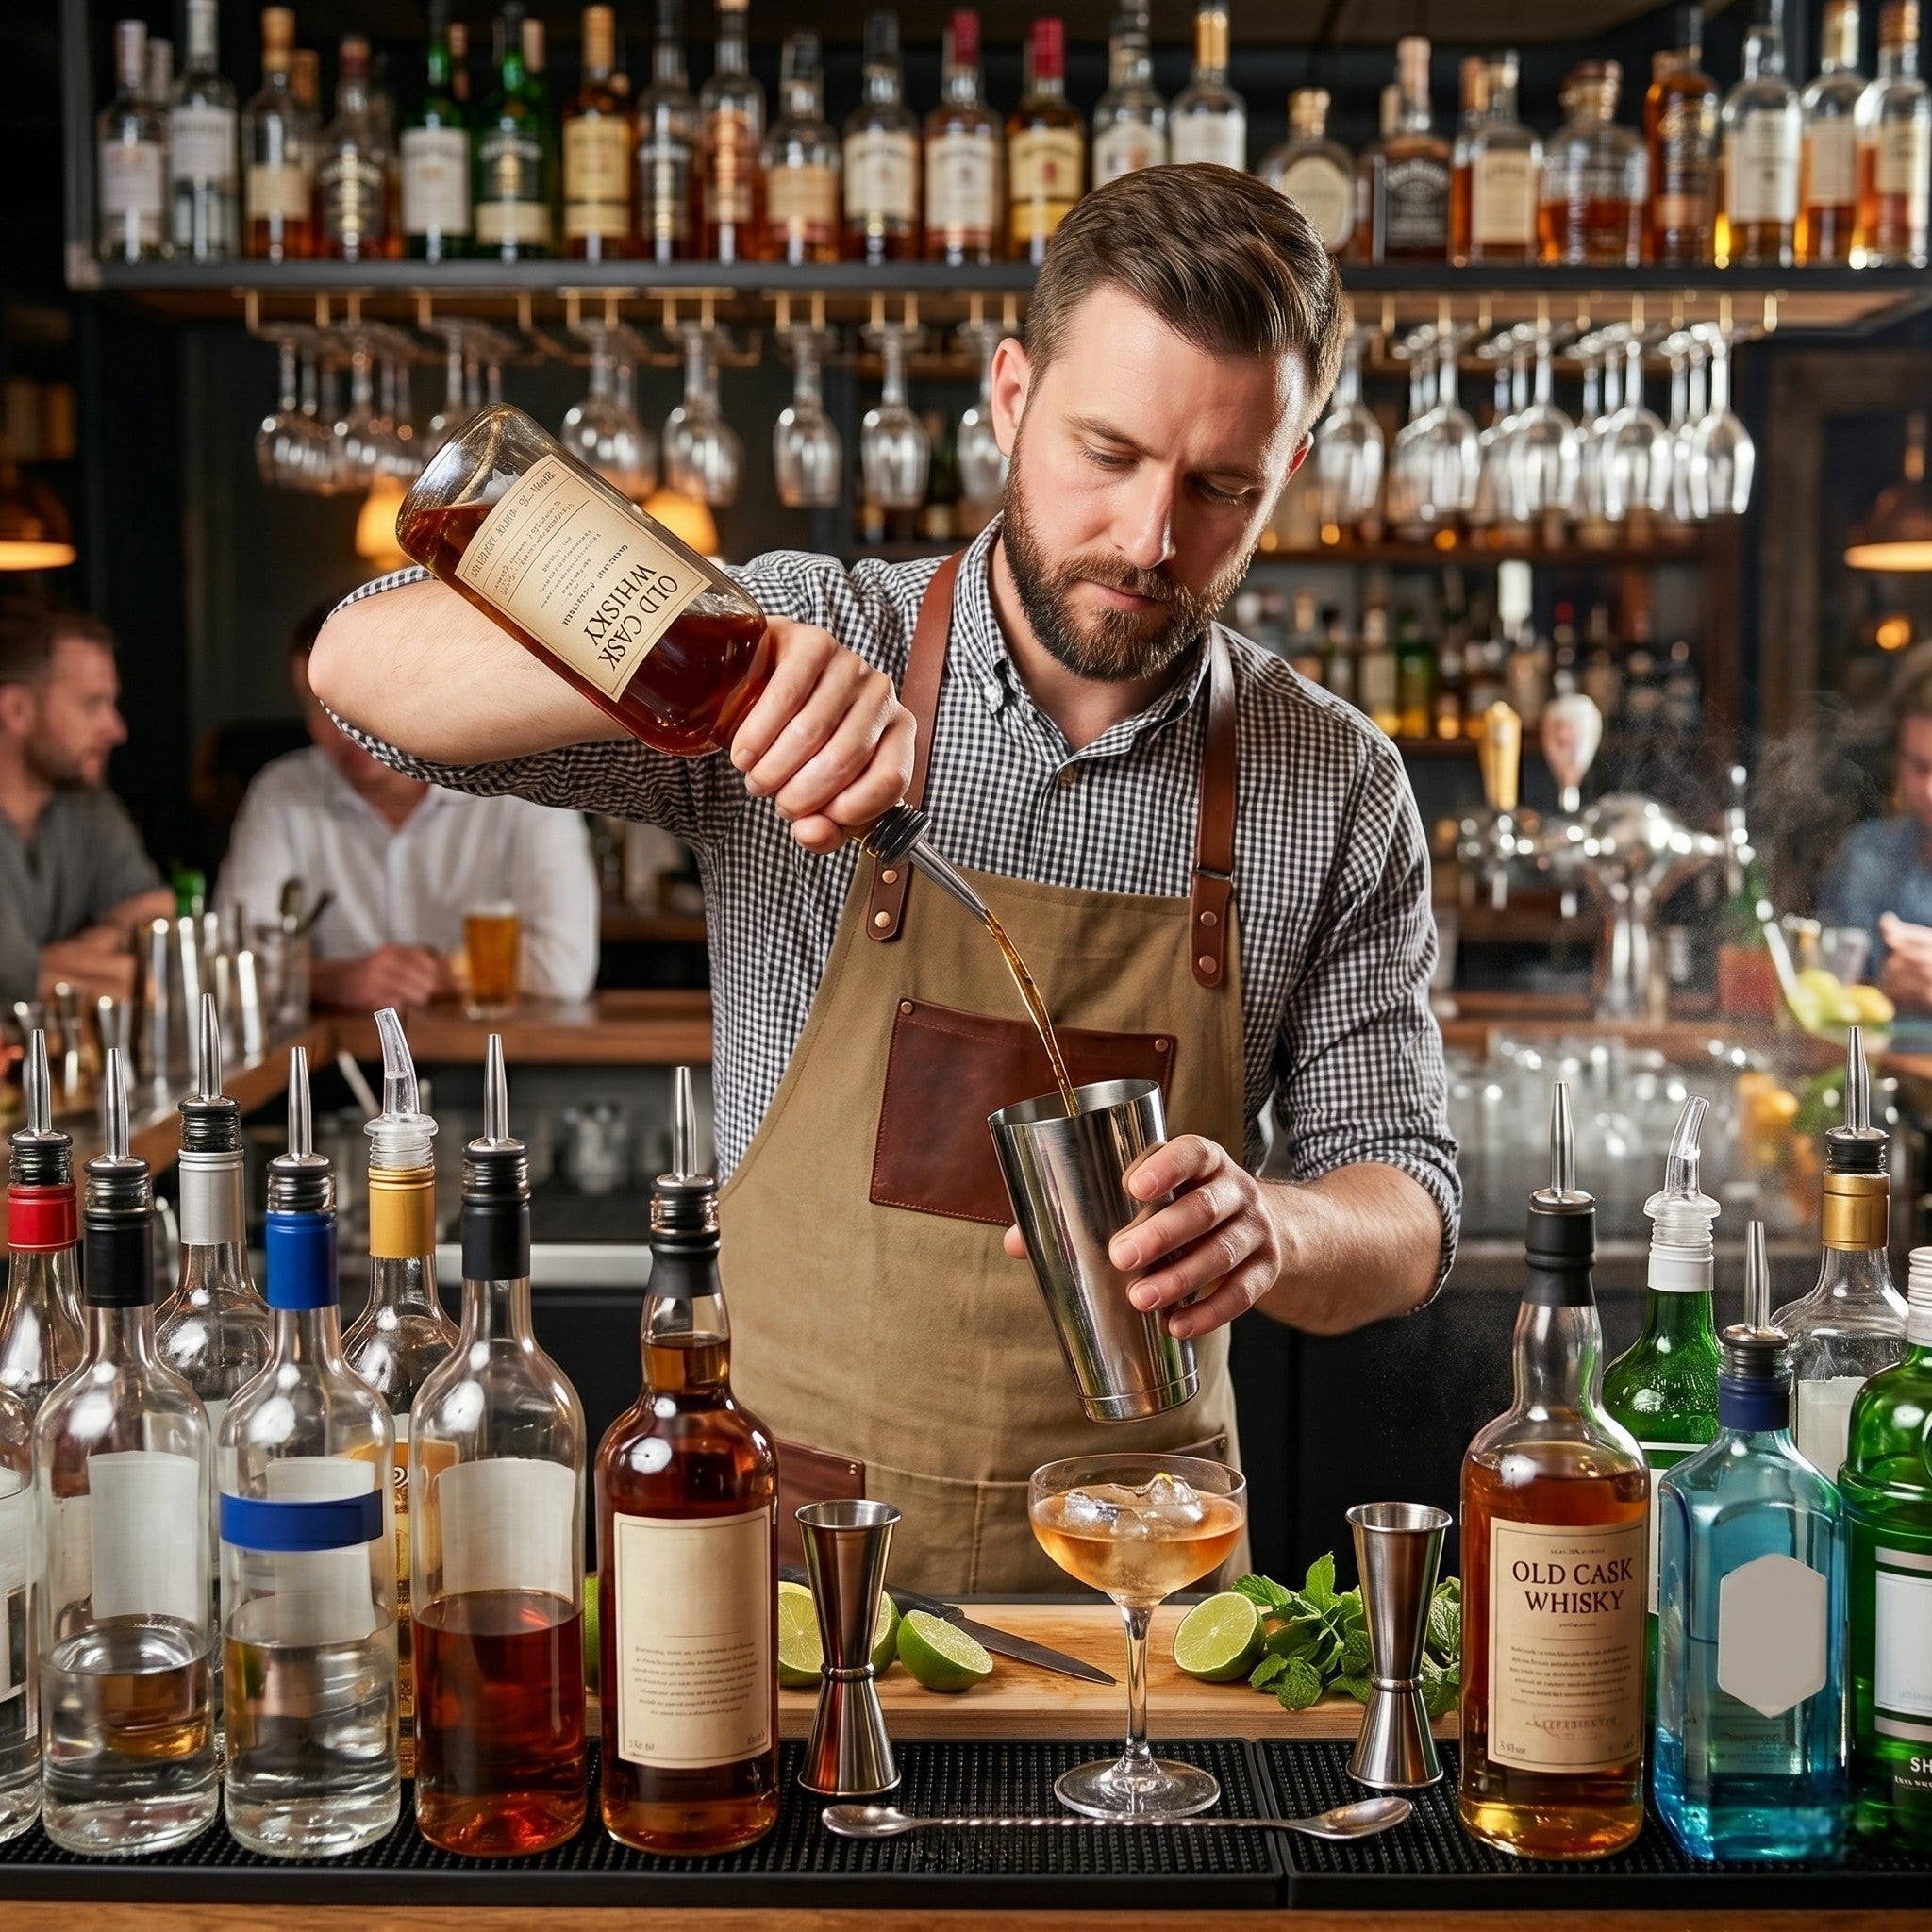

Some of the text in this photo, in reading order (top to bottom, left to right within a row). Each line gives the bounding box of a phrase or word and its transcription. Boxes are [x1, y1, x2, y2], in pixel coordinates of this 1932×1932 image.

[583, 564, 657, 646] WHISKY
[597, 575, 678, 672] OLD CASK
[1512, 1557, 1633, 1585] OLD CASK
[1524, 1589, 1624, 1614] WHISKY
